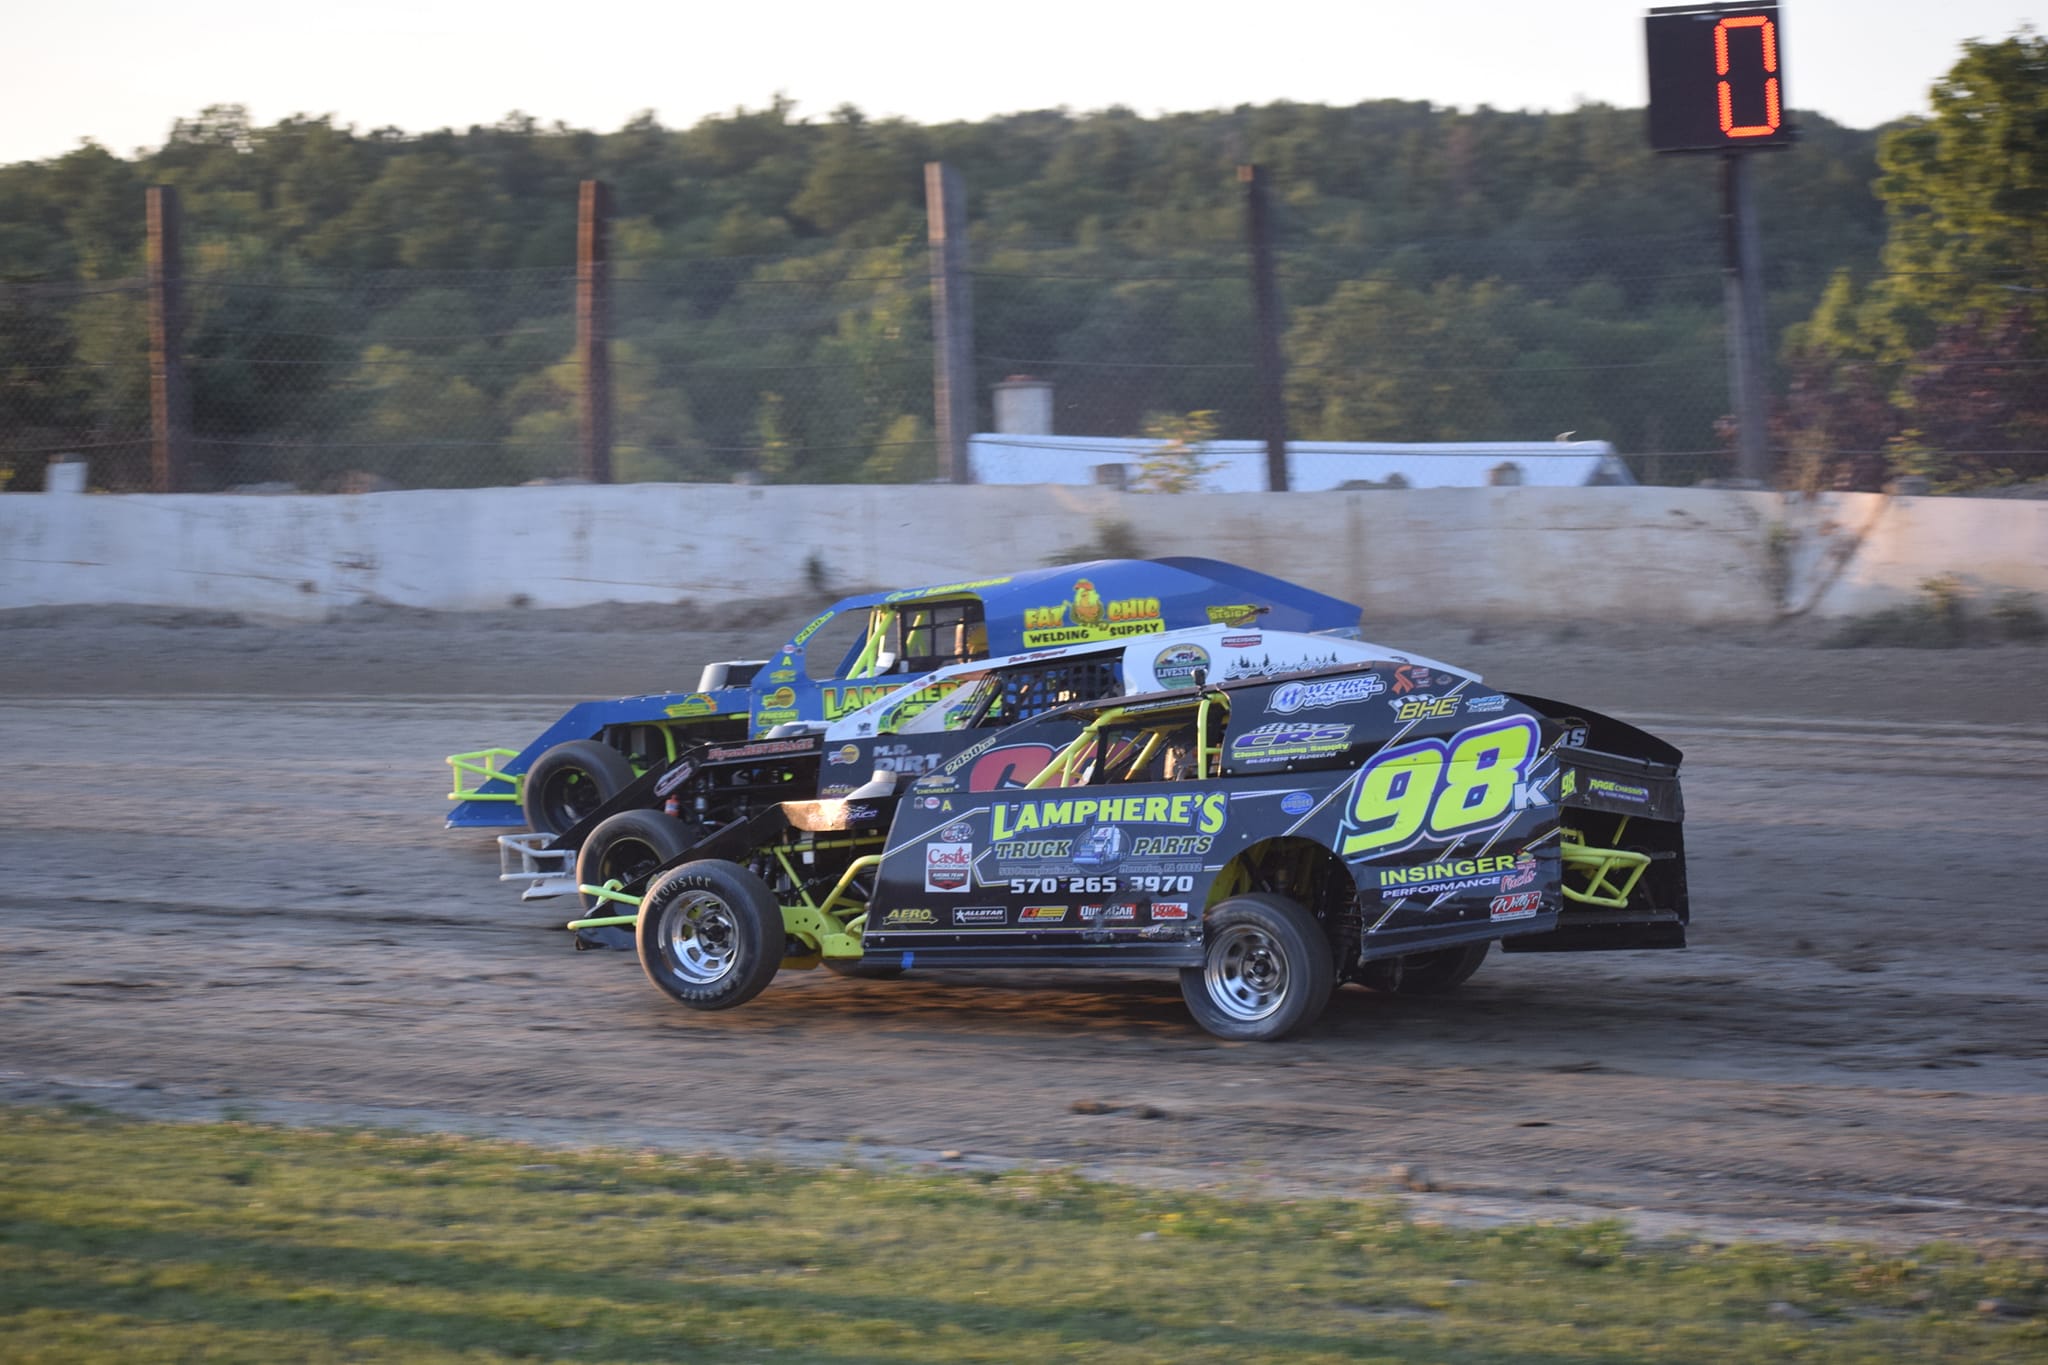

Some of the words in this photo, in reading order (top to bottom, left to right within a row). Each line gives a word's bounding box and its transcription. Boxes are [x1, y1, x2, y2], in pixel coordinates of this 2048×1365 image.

[1024, 604, 1066, 629] FAT
[1108, 598, 1160, 621] CHIC
[1029, 630, 1089, 644] WELDING
[1110, 623, 1158, 636] SUPPLY
[781, 655, 792, 666] A
[1307, 677, 1376, 695] WEHRS
[1399, 697, 1460, 720] BHE
[1233, 725, 1352, 748] CRS
[1310, 743, 1348, 753] Supply
[874, 753, 941, 773] DIRT
[916, 787, 954, 795] CHEVROLET
[1561, 769, 1576, 798] 98
[941, 799, 953, 811] A
[992, 793, 1225, 841] LAMPHERE'S
[928, 846, 969, 864] Castle
[996, 839, 1072, 860] TRUCK
[1132, 836, 1214, 856] PARTS
[1380, 855, 1516, 886] INSINGER
[1010, 877, 1057, 893] 570
[1069, 877, 1116, 893] 265
[1129, 876, 1194, 892] 3970
[1382, 877, 1500, 899] PERFORMANCE
[888, 909, 931, 920] AERO
